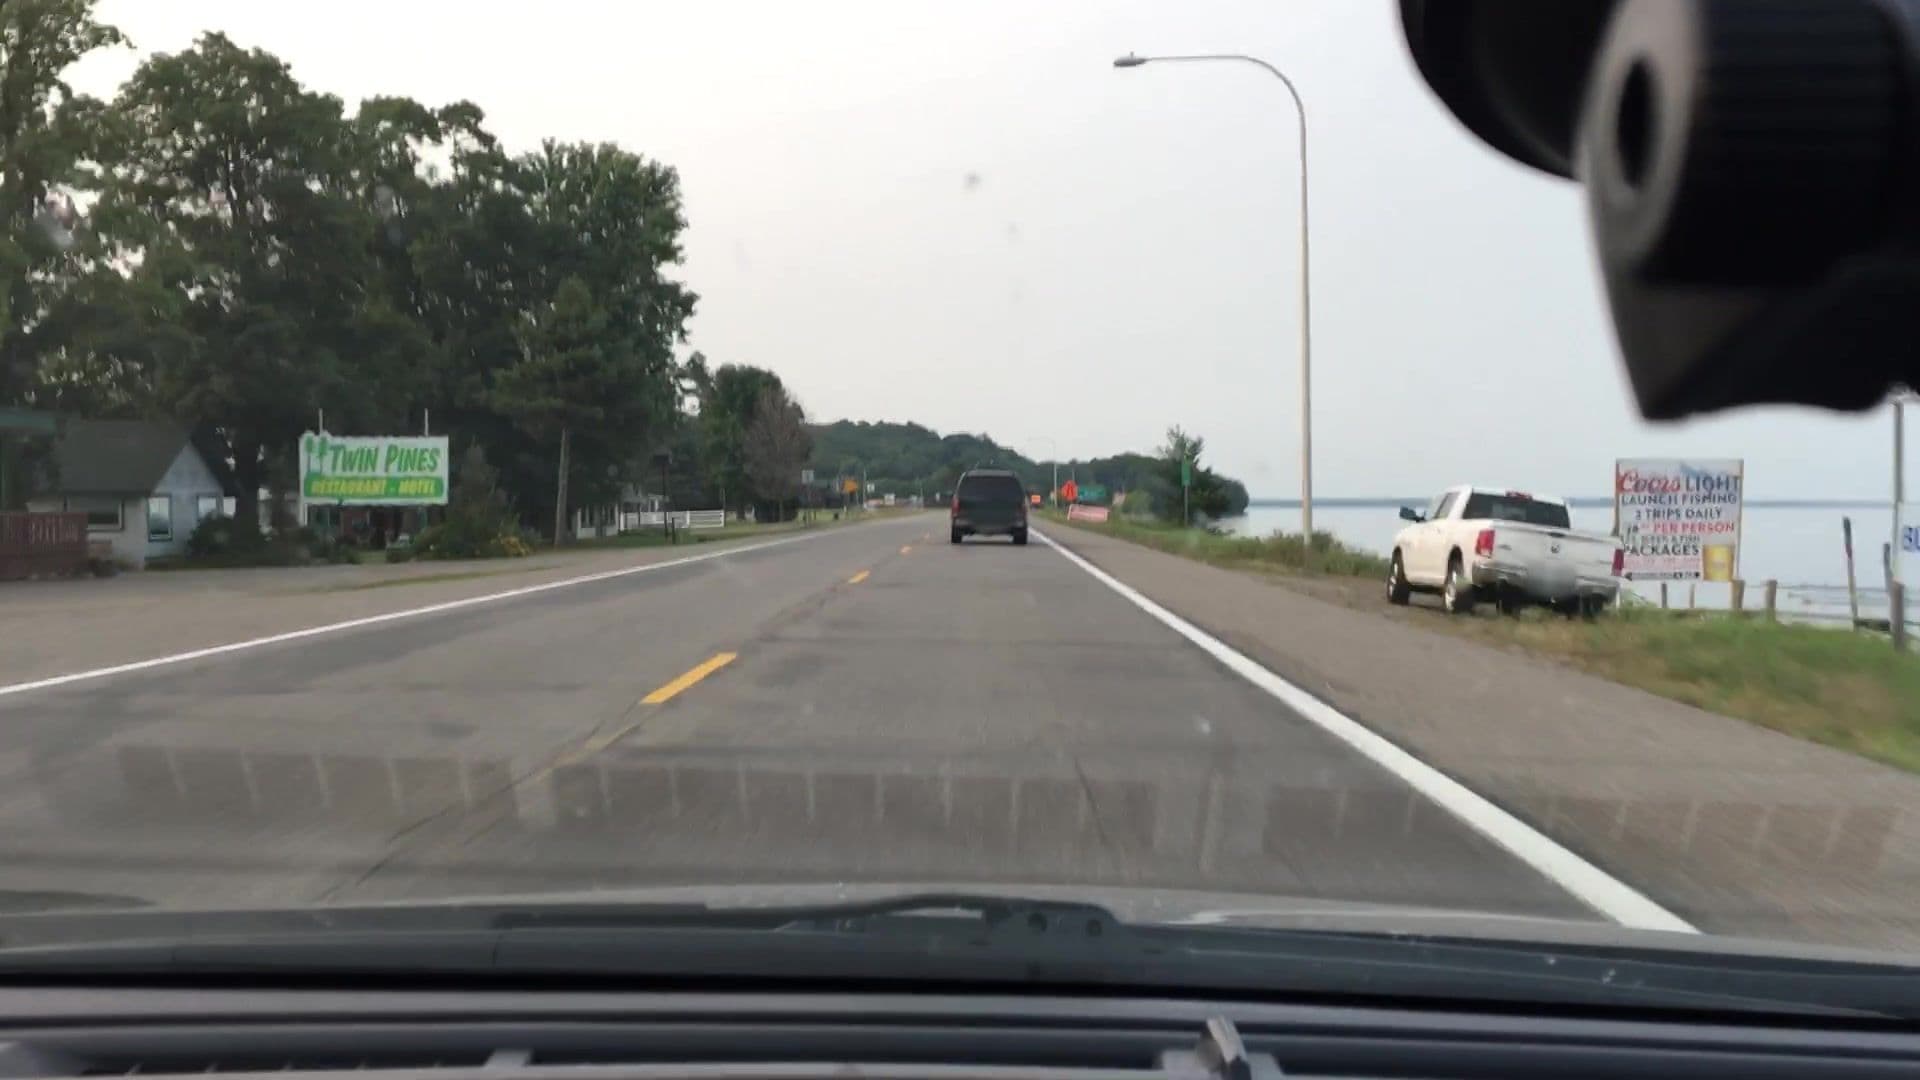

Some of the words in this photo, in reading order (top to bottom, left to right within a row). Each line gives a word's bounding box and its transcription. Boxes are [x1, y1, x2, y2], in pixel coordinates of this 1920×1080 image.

[329, 444, 378, 472] TWIN
[384, 444, 440, 472] PINES
[312, 479, 386, 495] RESTAURANT
[398, 479, 435, 495] MOTEL
[1686, 475, 1739, 492] LIGHT
[1621, 494, 1677, 505] LAUNCH
[1682, 493, 1737, 505] FISHING
[1645, 508, 1681, 520] TRIPS
[1685, 508, 1722, 520] DAILY
[1653, 522, 1678, 534] PER
[1681, 522, 1735, 534] PERSON
[1623, 543, 1699, 556] PACKAGES
